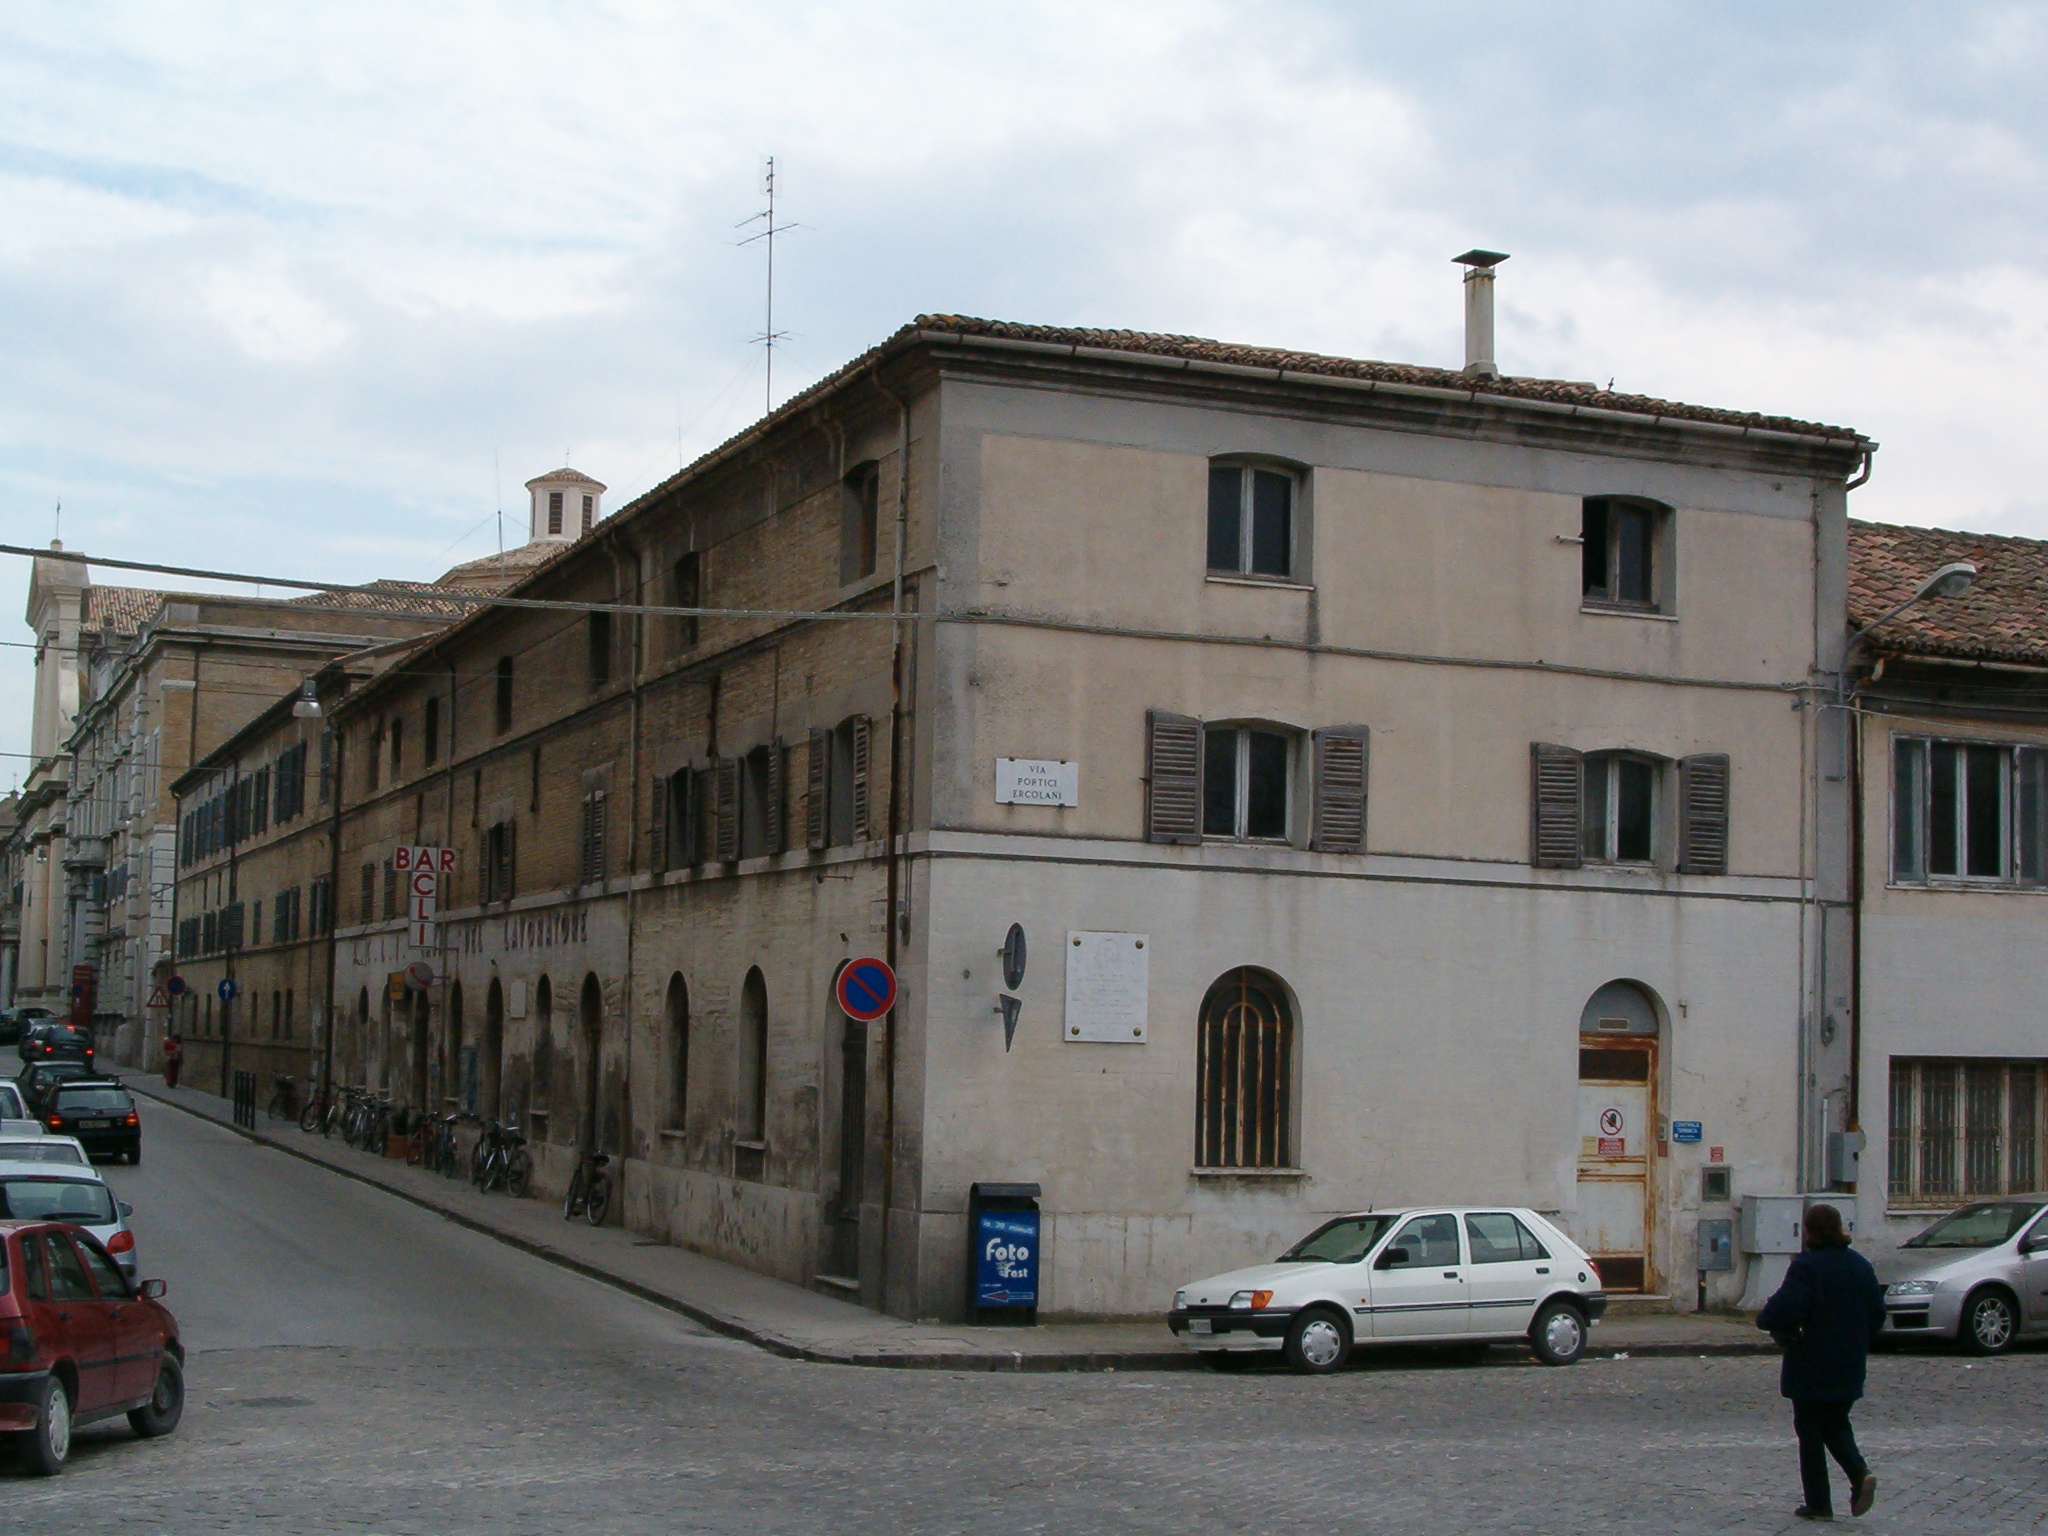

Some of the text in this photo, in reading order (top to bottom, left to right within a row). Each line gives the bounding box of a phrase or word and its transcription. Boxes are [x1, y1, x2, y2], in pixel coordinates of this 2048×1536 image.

[1029, 765, 1046, 774] VIA
[1017, 777, 1058, 787] PORTICI
[1013, 789, 1062, 800] ERCOLANI
[396, 846, 456, 872] BAR
